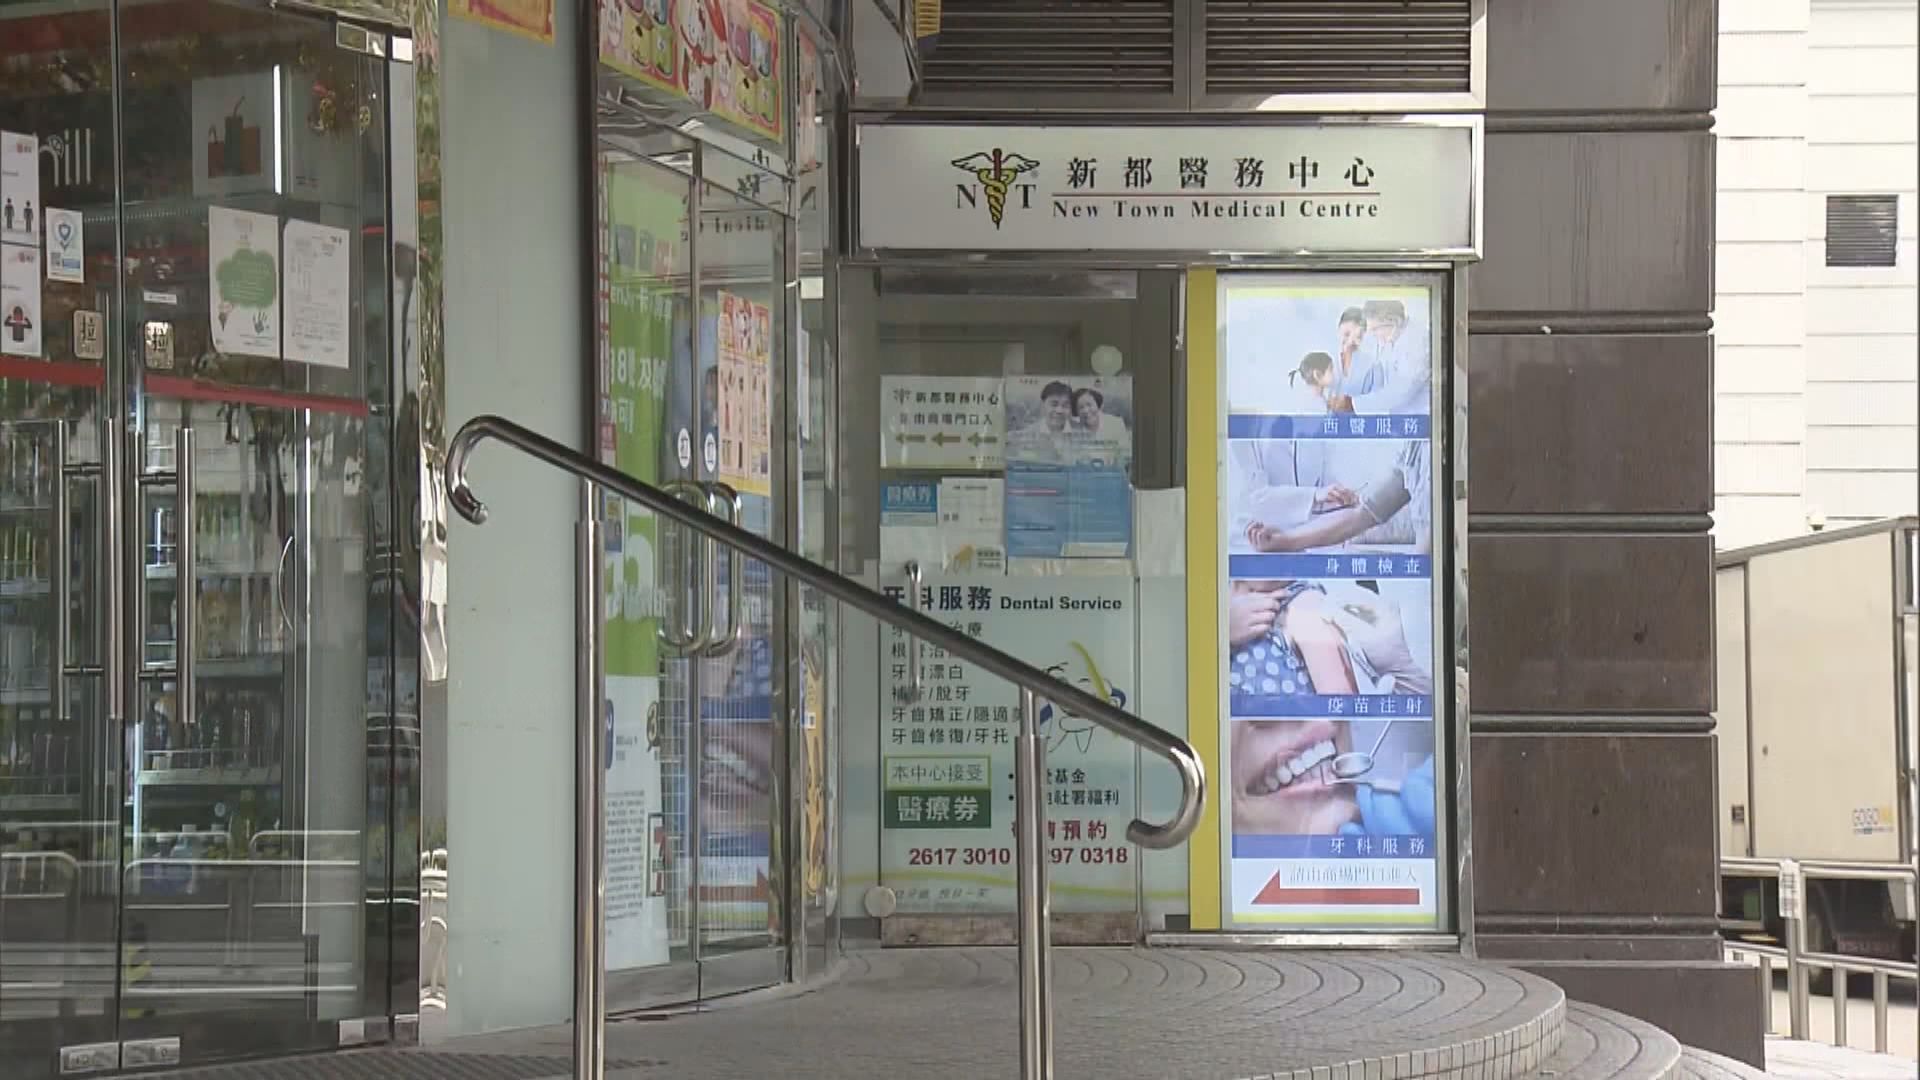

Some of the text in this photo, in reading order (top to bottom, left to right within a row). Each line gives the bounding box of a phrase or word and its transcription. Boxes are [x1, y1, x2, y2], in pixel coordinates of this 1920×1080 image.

[1067, 157, 1376, 189] 新都醫務中心
[1052, 200, 1379, 219] New Town Medical Centre
[1324, 418, 1418, 435] 西醫服務
[1327, 558, 1420, 575] 身體檢查
[1000, 596, 1122, 610] Dental Service
[892, 664, 963, 680] 牙漂白
[1328, 697, 1422, 714] 疫苗注射
[892, 764, 983, 782] 本中心接受
[1331, 838, 1425, 854] 牙科服務
[909, 848, 956, 865] 2617
[964, 848, 1010, 865] 3010
[1081, 847, 1128, 864] 0318
